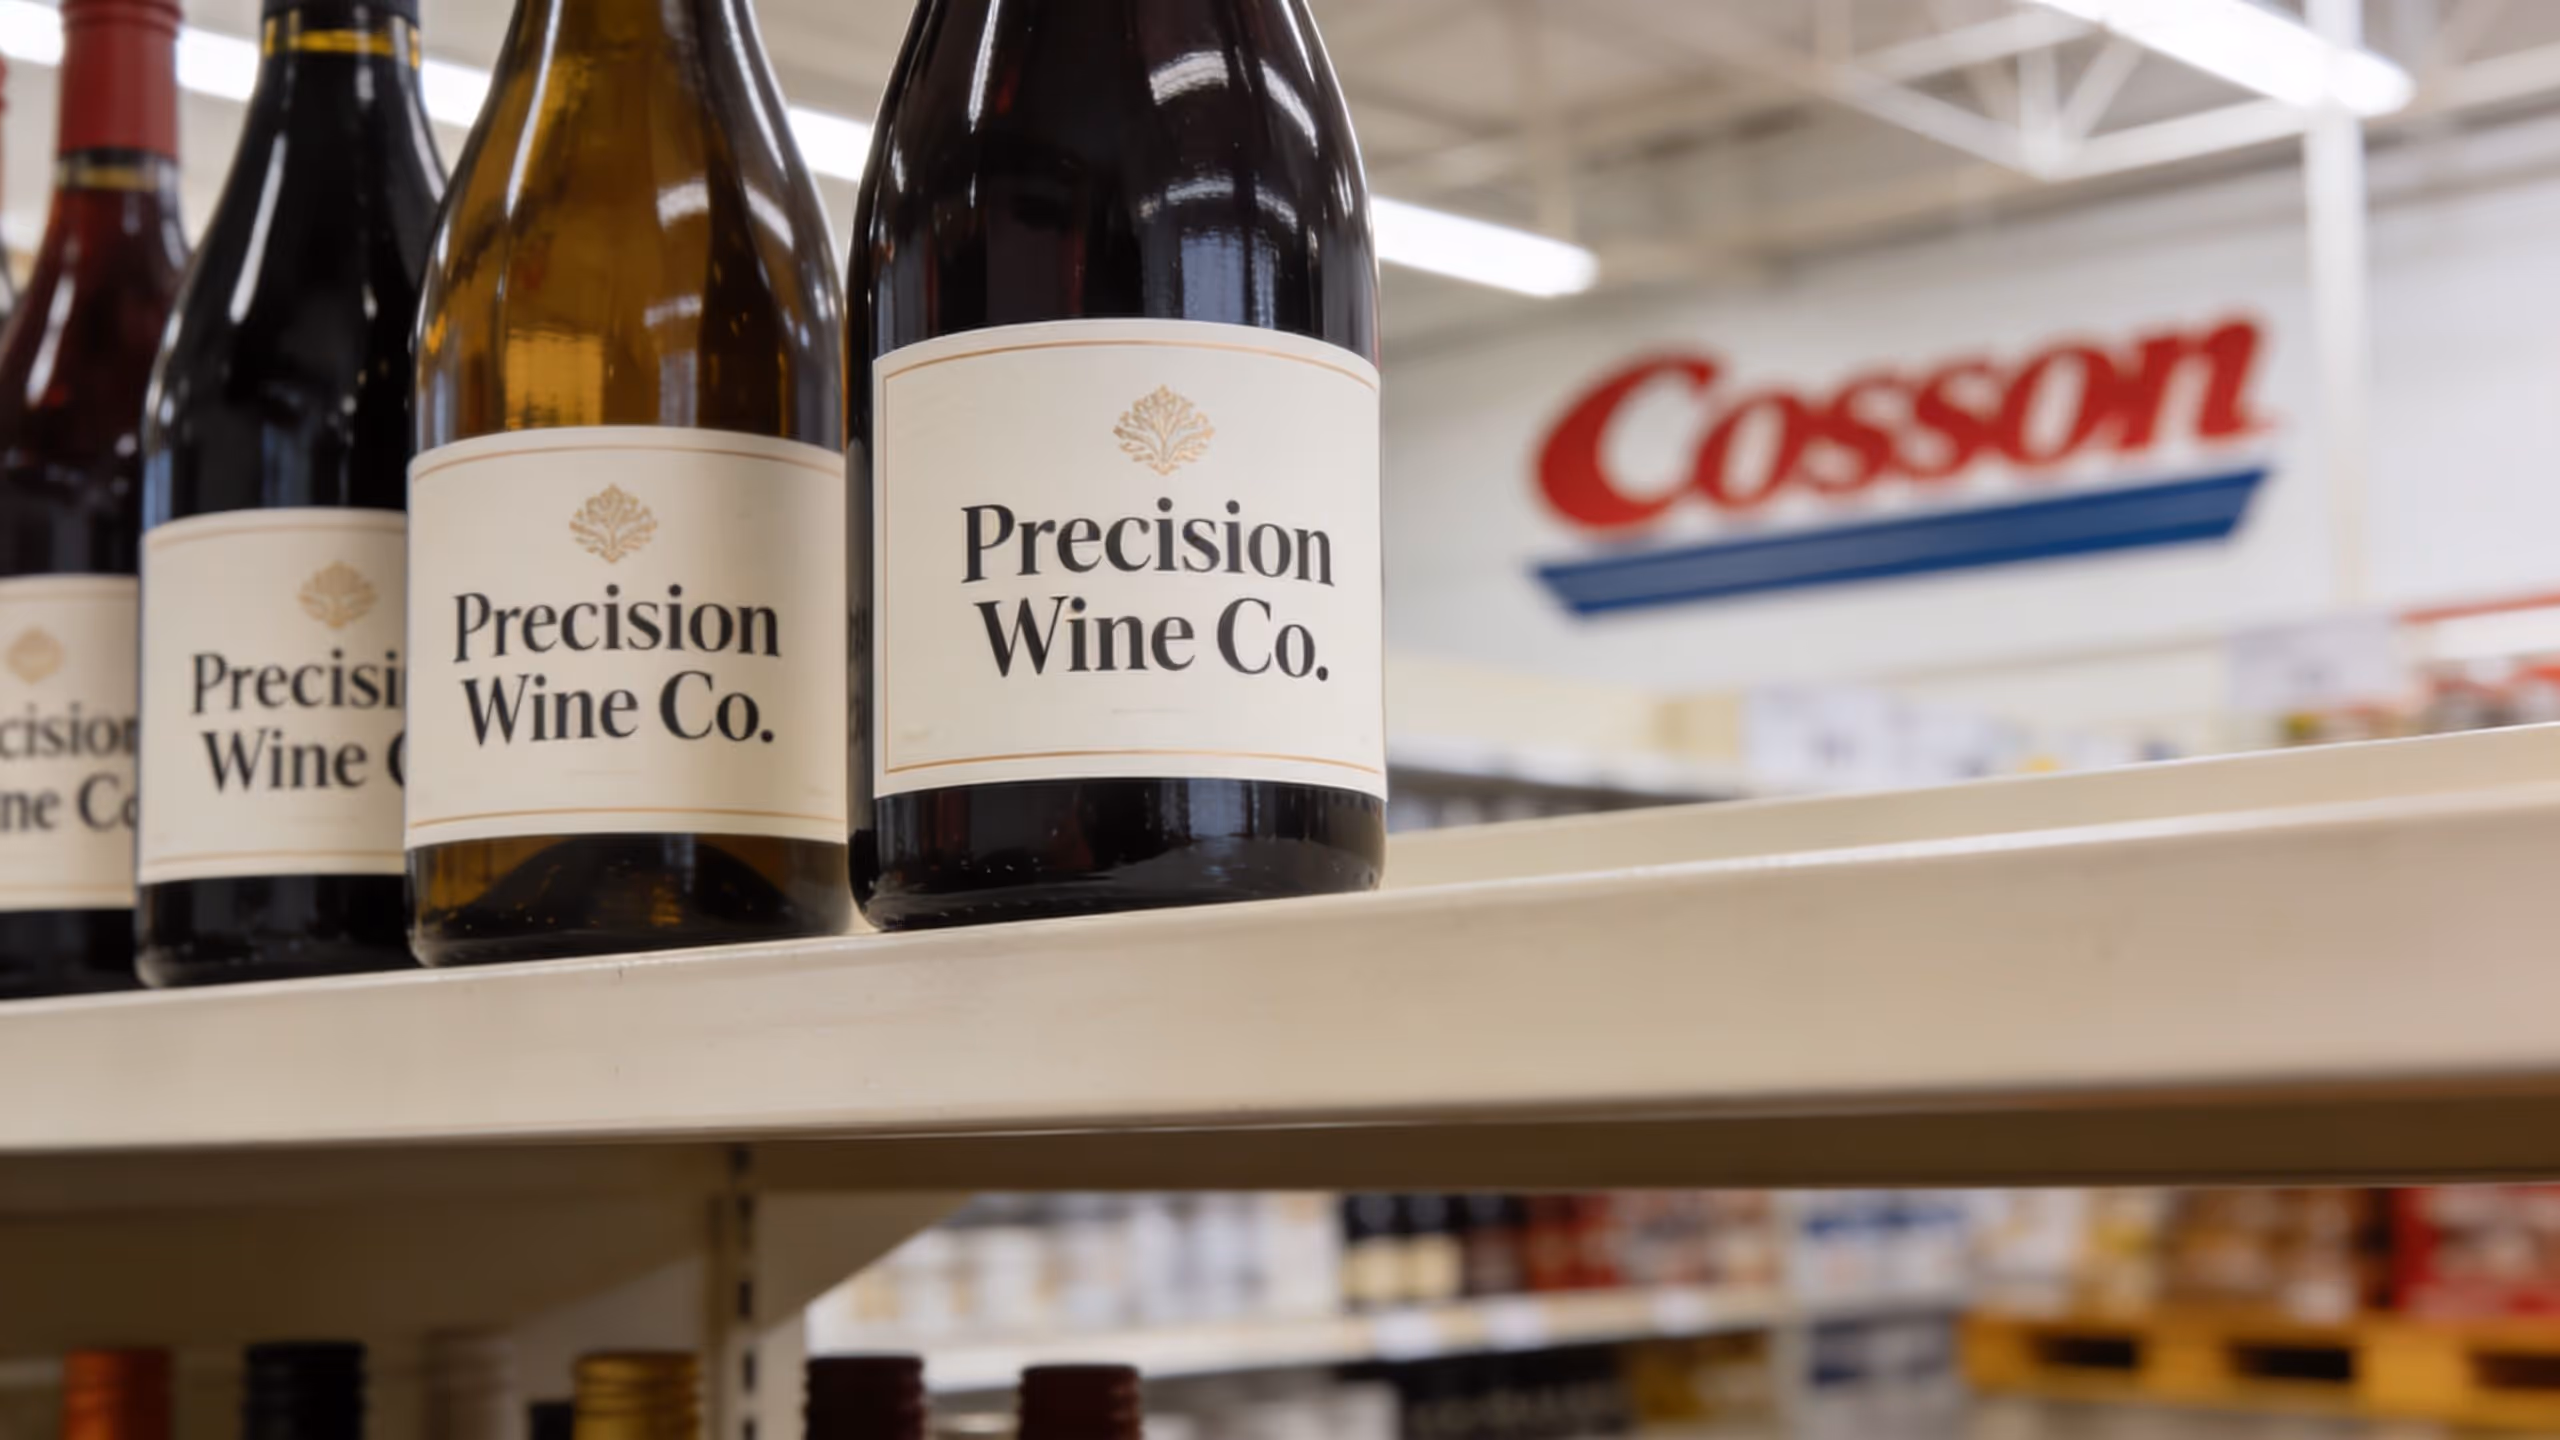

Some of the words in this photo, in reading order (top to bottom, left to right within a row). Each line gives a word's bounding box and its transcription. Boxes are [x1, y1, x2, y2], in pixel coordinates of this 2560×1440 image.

[1530, 310, 2268, 536] Cosson
[961, 497, 1335, 587] Precision
[453, 584, 781, 663] Precision
[973, 596, 1196, 677] Wine
[1216, 597, 1329, 682] Co.
[190, 648, 407, 716] Precisi
[460, 673, 639, 747] Wine
[659, 670, 775, 744] Co.
[200, 727, 369, 793] Wine
